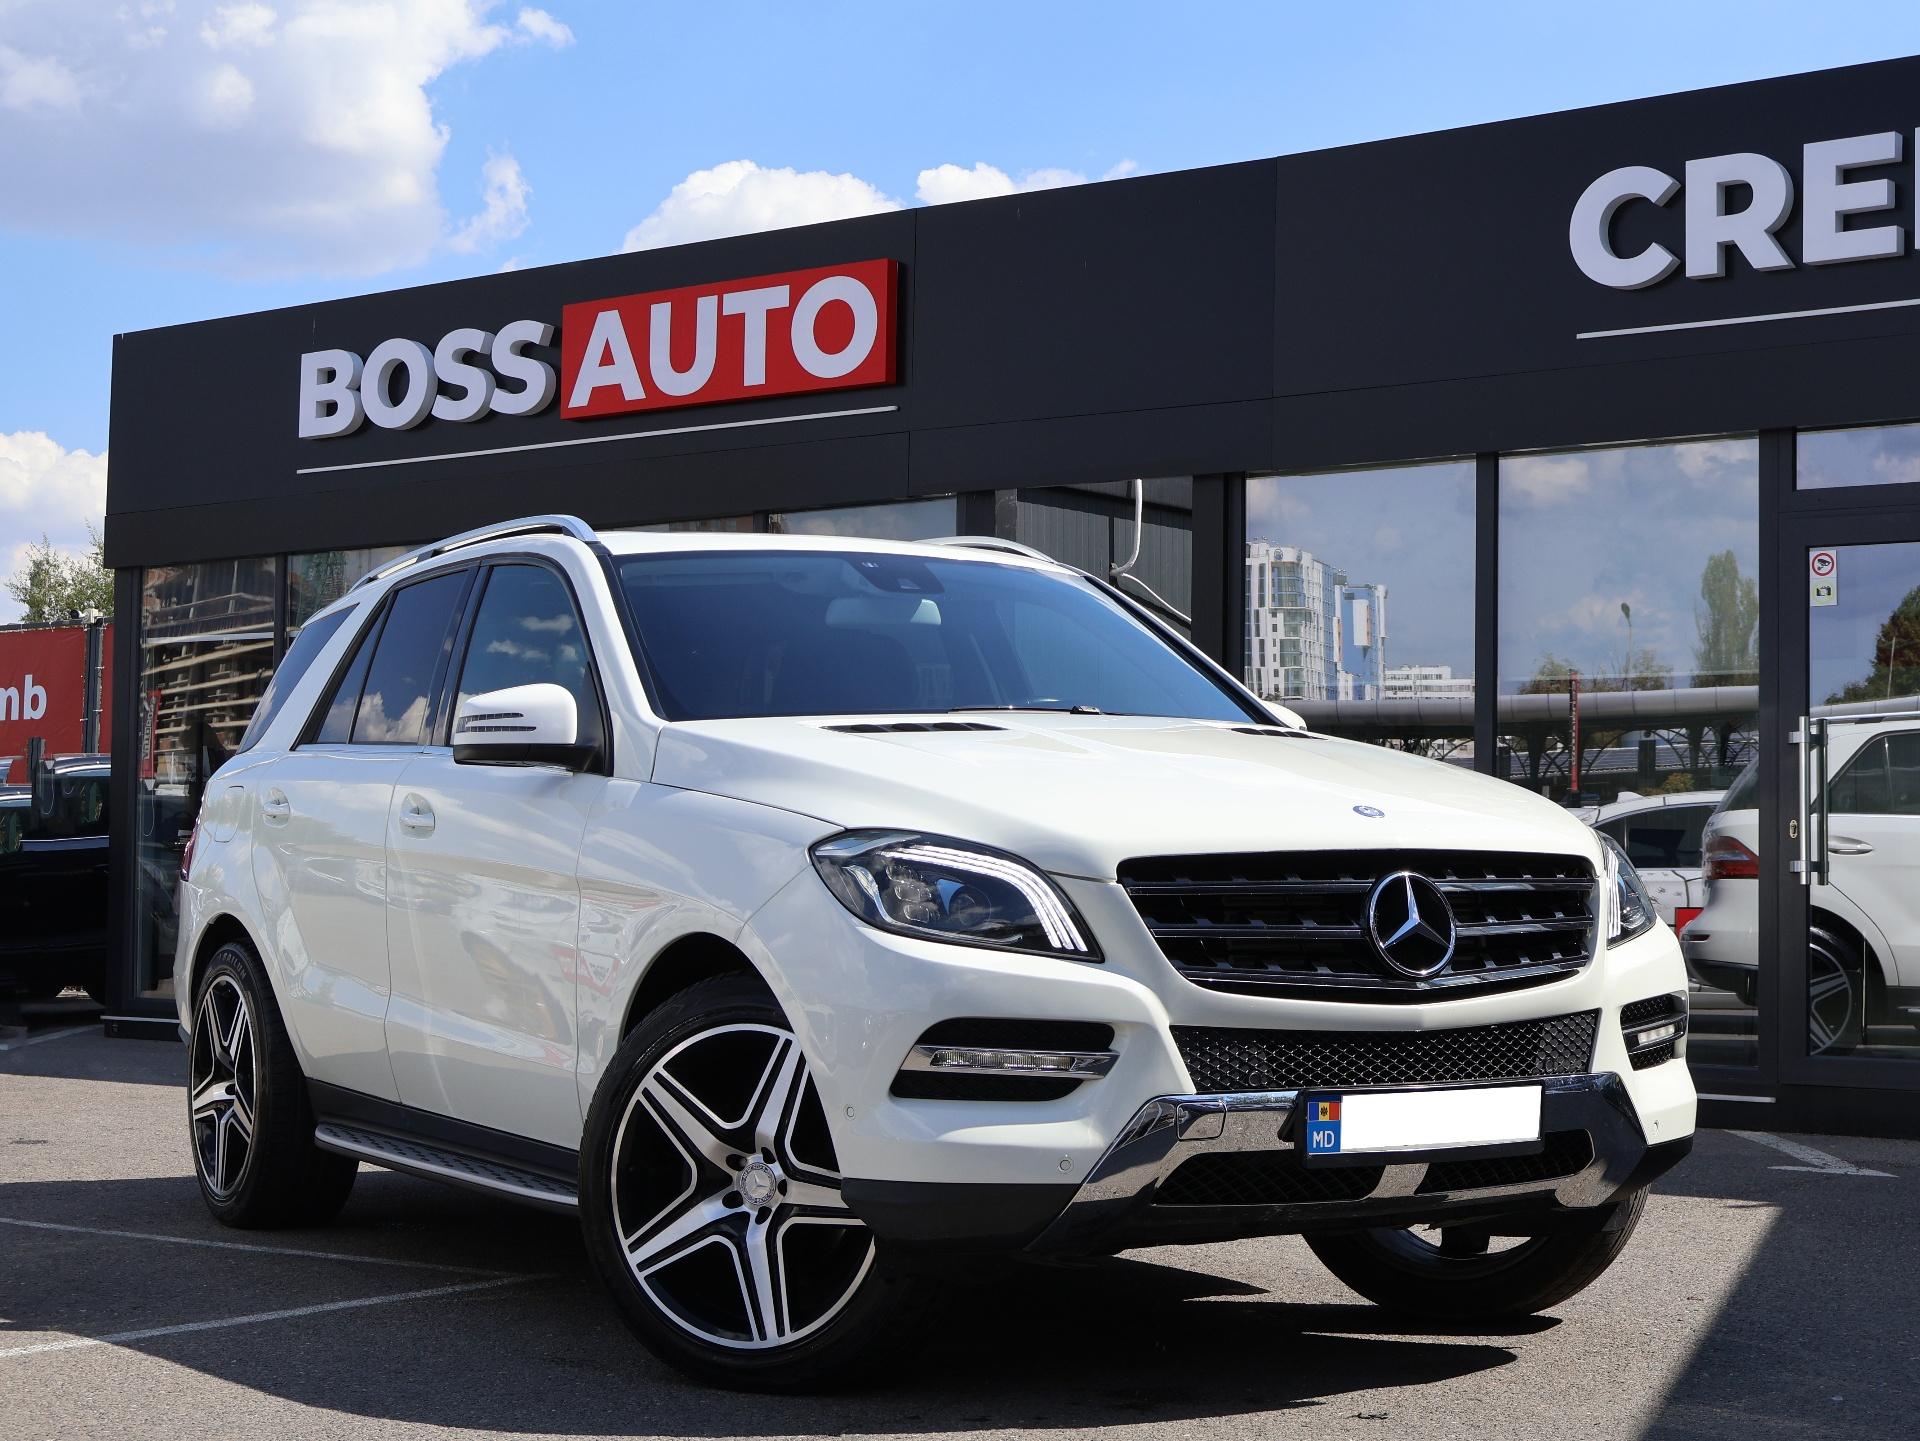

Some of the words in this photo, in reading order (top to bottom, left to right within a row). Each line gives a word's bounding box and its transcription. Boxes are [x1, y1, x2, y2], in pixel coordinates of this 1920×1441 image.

[1569, 127, 1920, 290] CRE
[299, 319, 556, 441] BOSS
[568, 275, 878, 409] AUTO
[1312, 1130, 1335, 1149] MD
